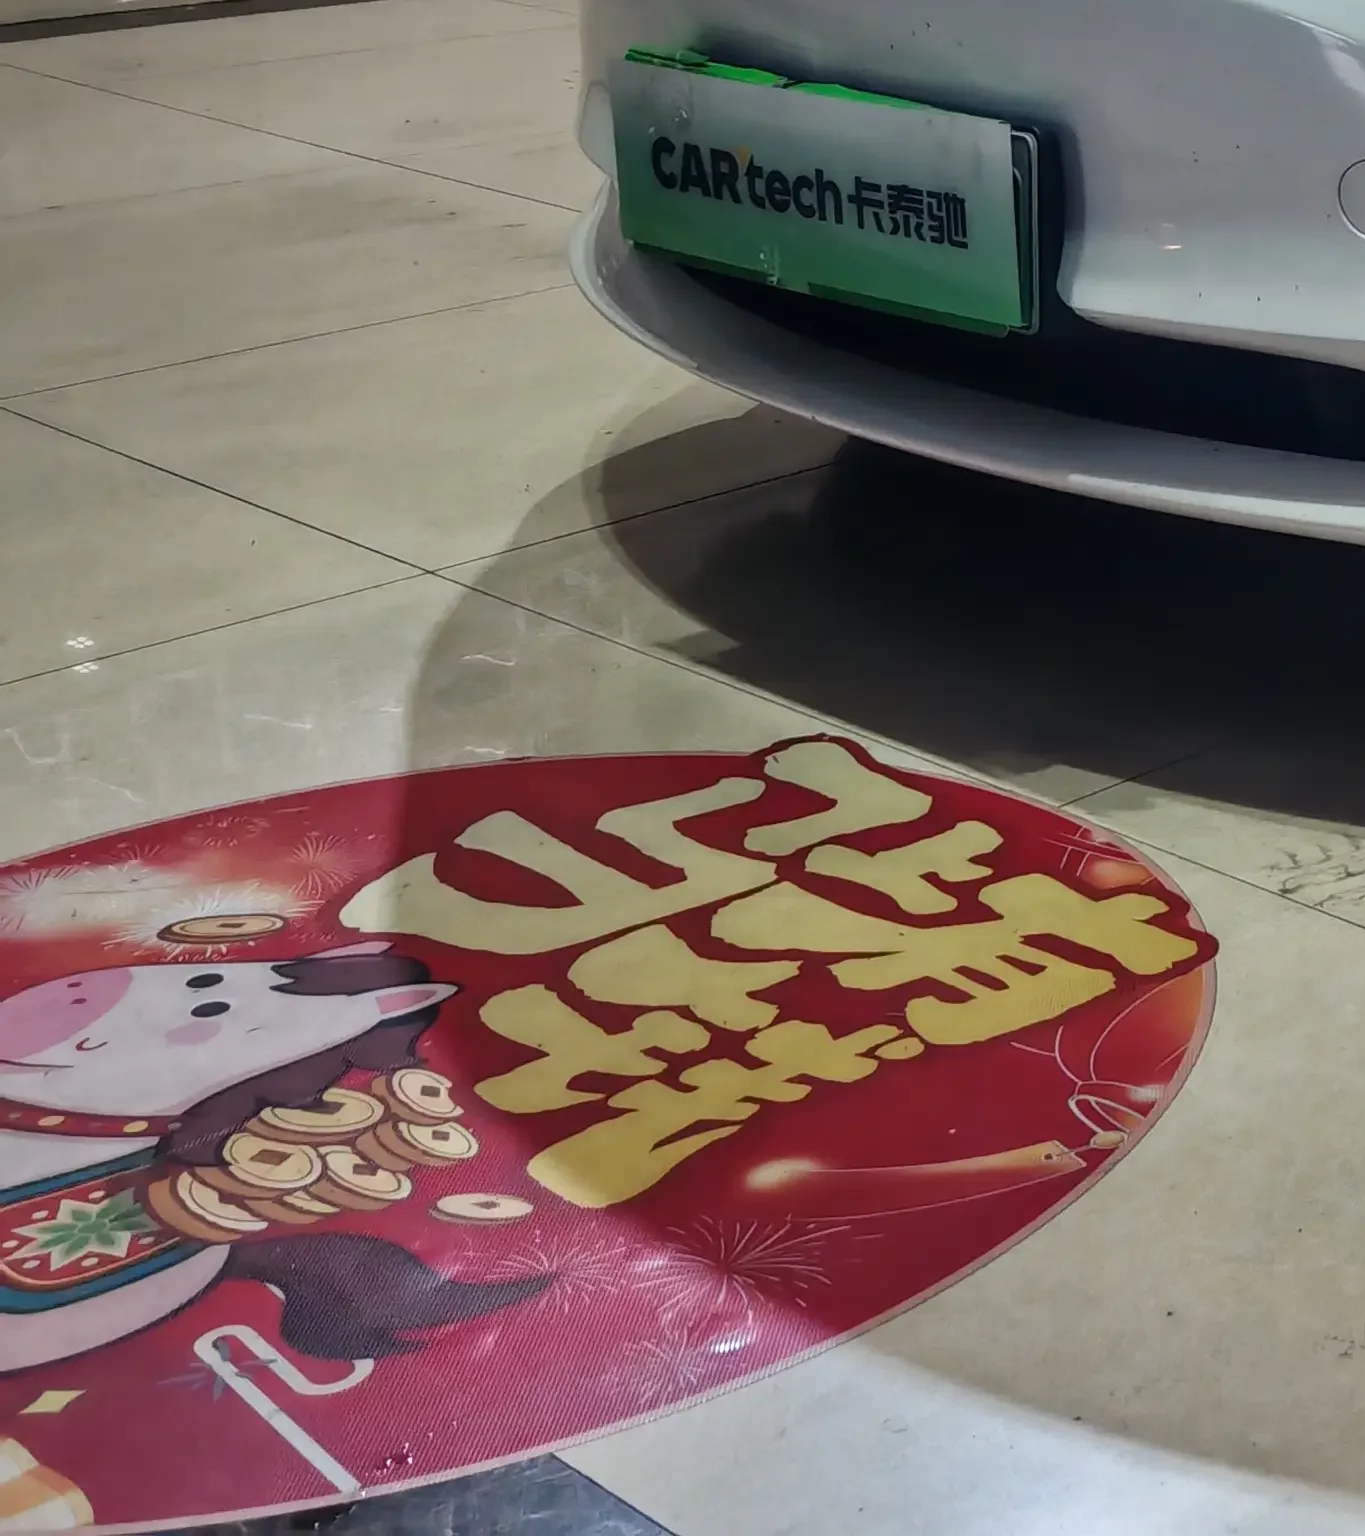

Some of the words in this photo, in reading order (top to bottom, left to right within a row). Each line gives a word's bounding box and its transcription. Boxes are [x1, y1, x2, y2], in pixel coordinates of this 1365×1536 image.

[650, 135, 844, 226] CARtech
[847, 175, 969, 250] 卡泰驰
